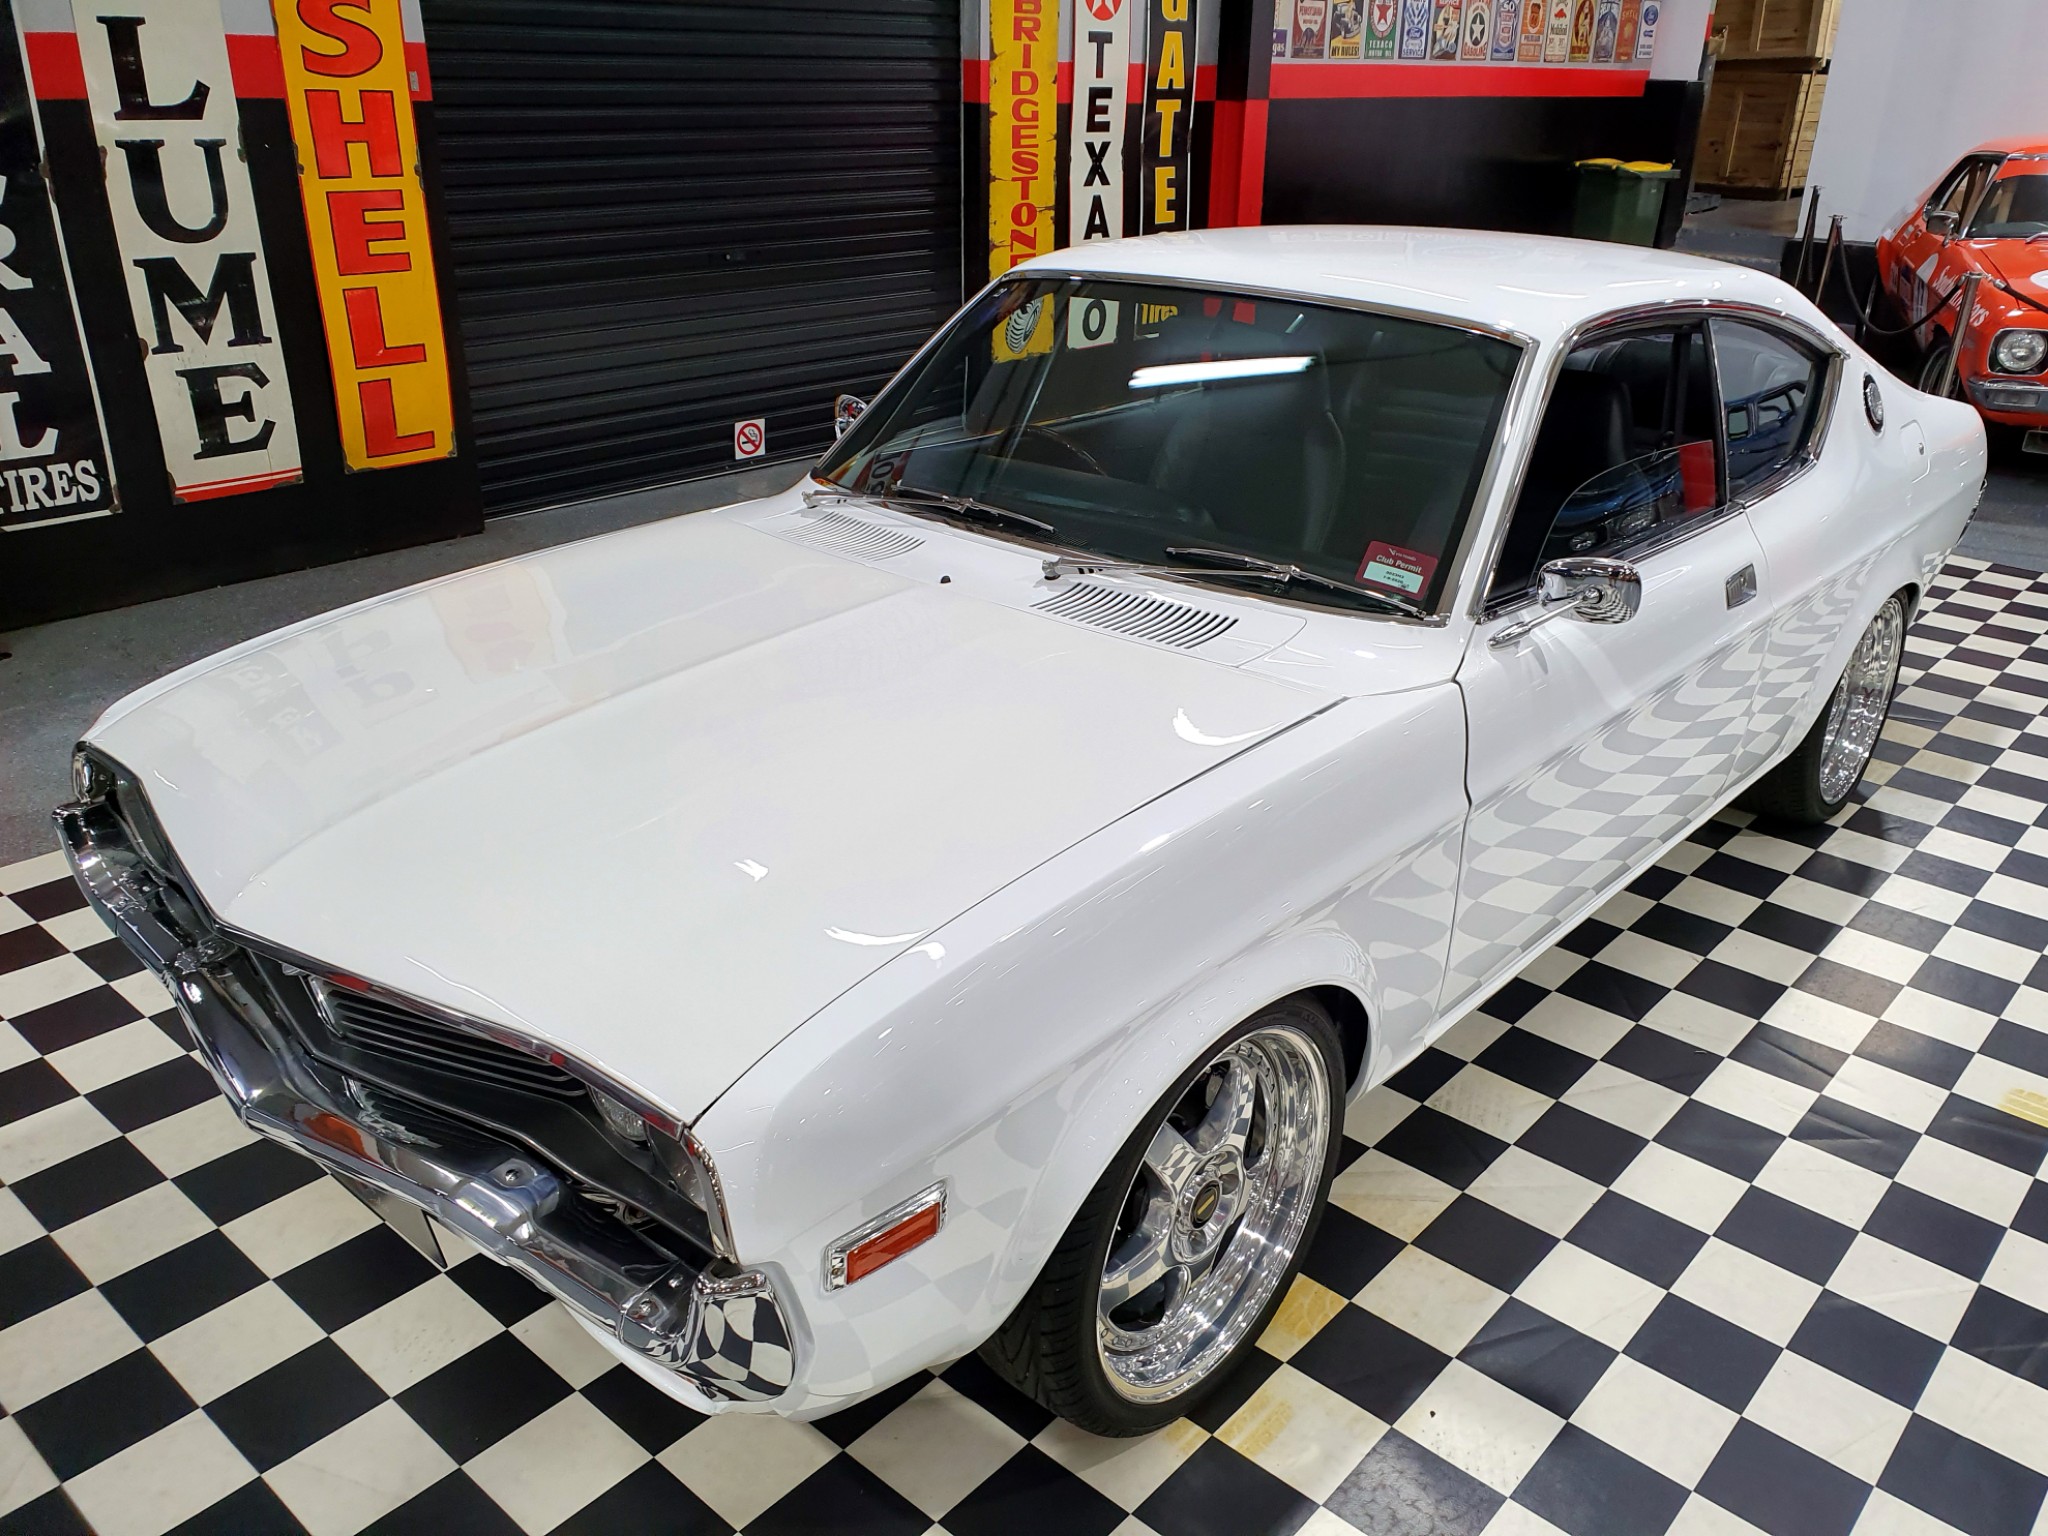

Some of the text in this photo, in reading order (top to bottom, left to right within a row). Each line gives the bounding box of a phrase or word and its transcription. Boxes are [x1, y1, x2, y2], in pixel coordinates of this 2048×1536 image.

[1369, 40, 1393, 49] TEXACO
[297, 0, 435, 458] SHELL
[1376, 554, 1395, 566] Club
[1395, 560, 1423, 574] Permit
